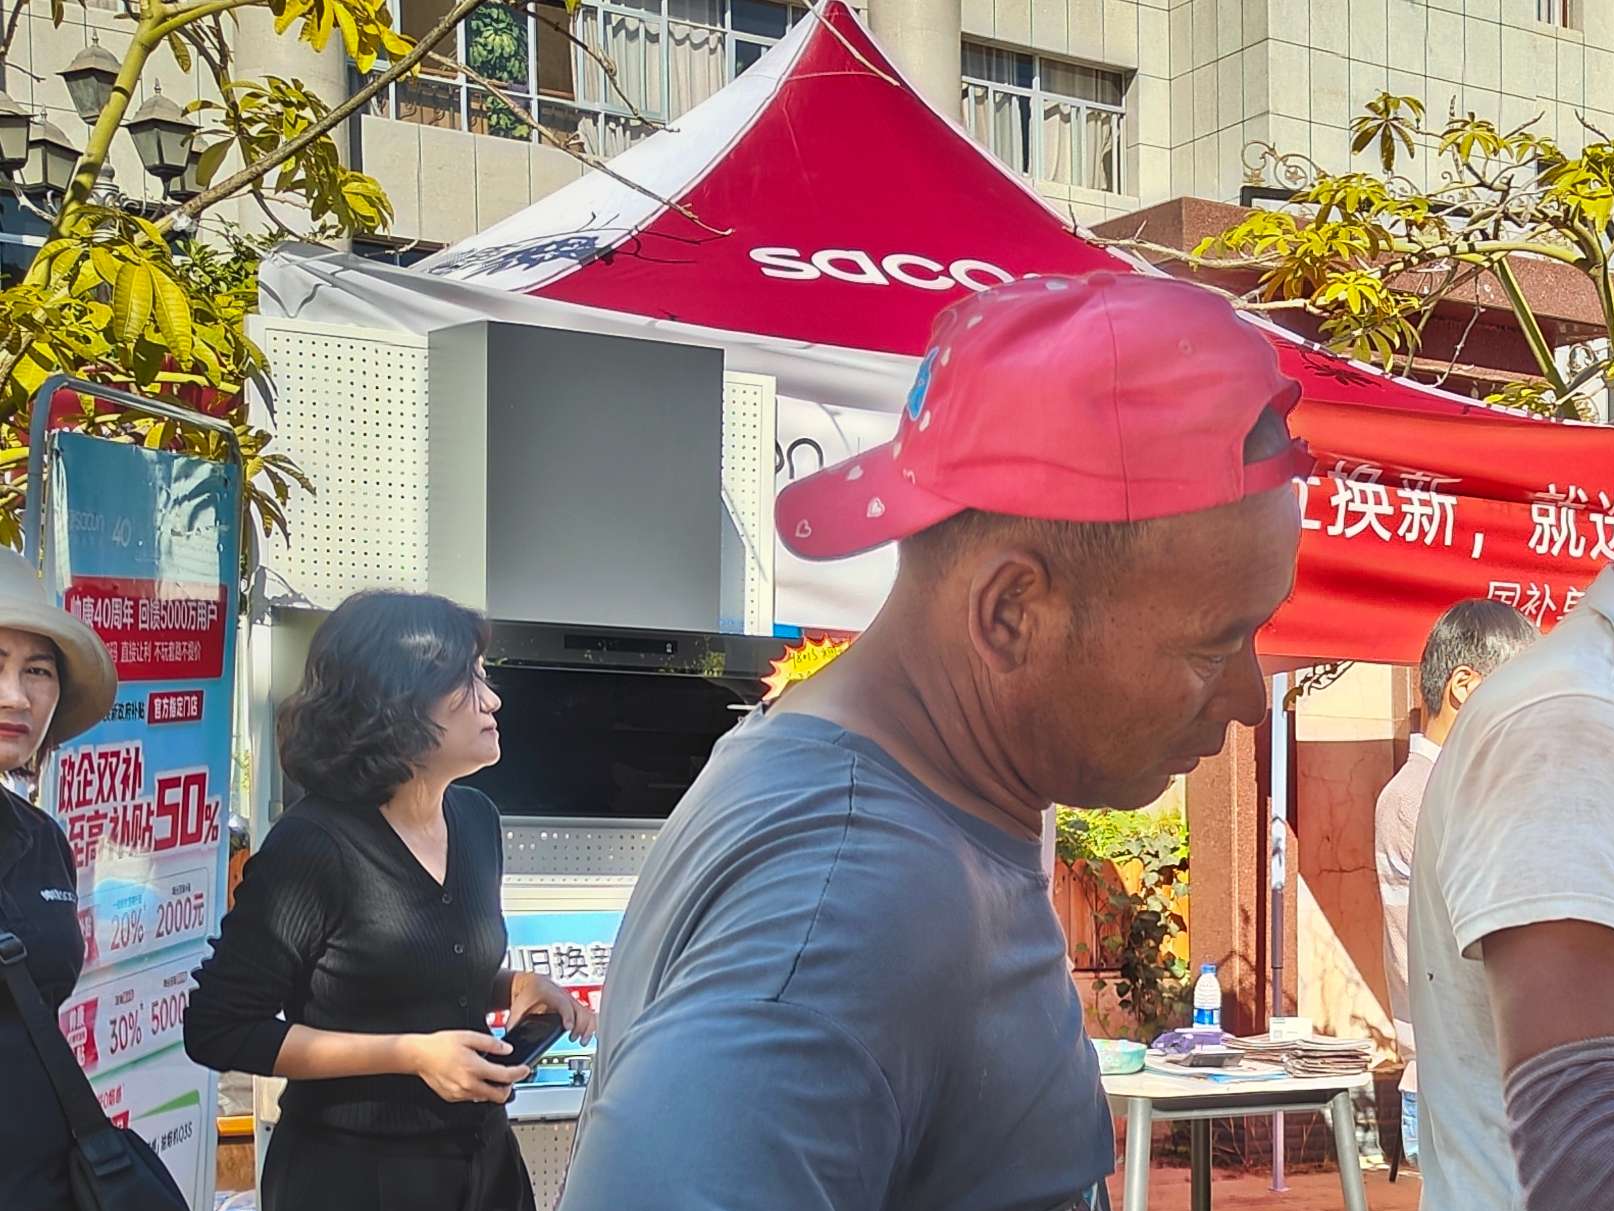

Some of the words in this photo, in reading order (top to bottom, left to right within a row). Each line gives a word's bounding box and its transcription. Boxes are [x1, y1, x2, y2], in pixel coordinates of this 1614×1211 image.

[749, 247, 1041, 292] saco
[58, 746, 143, 814] 政企双补
[155, 893, 205, 938] 2000元
[109, 1008, 143, 1055] 30%
